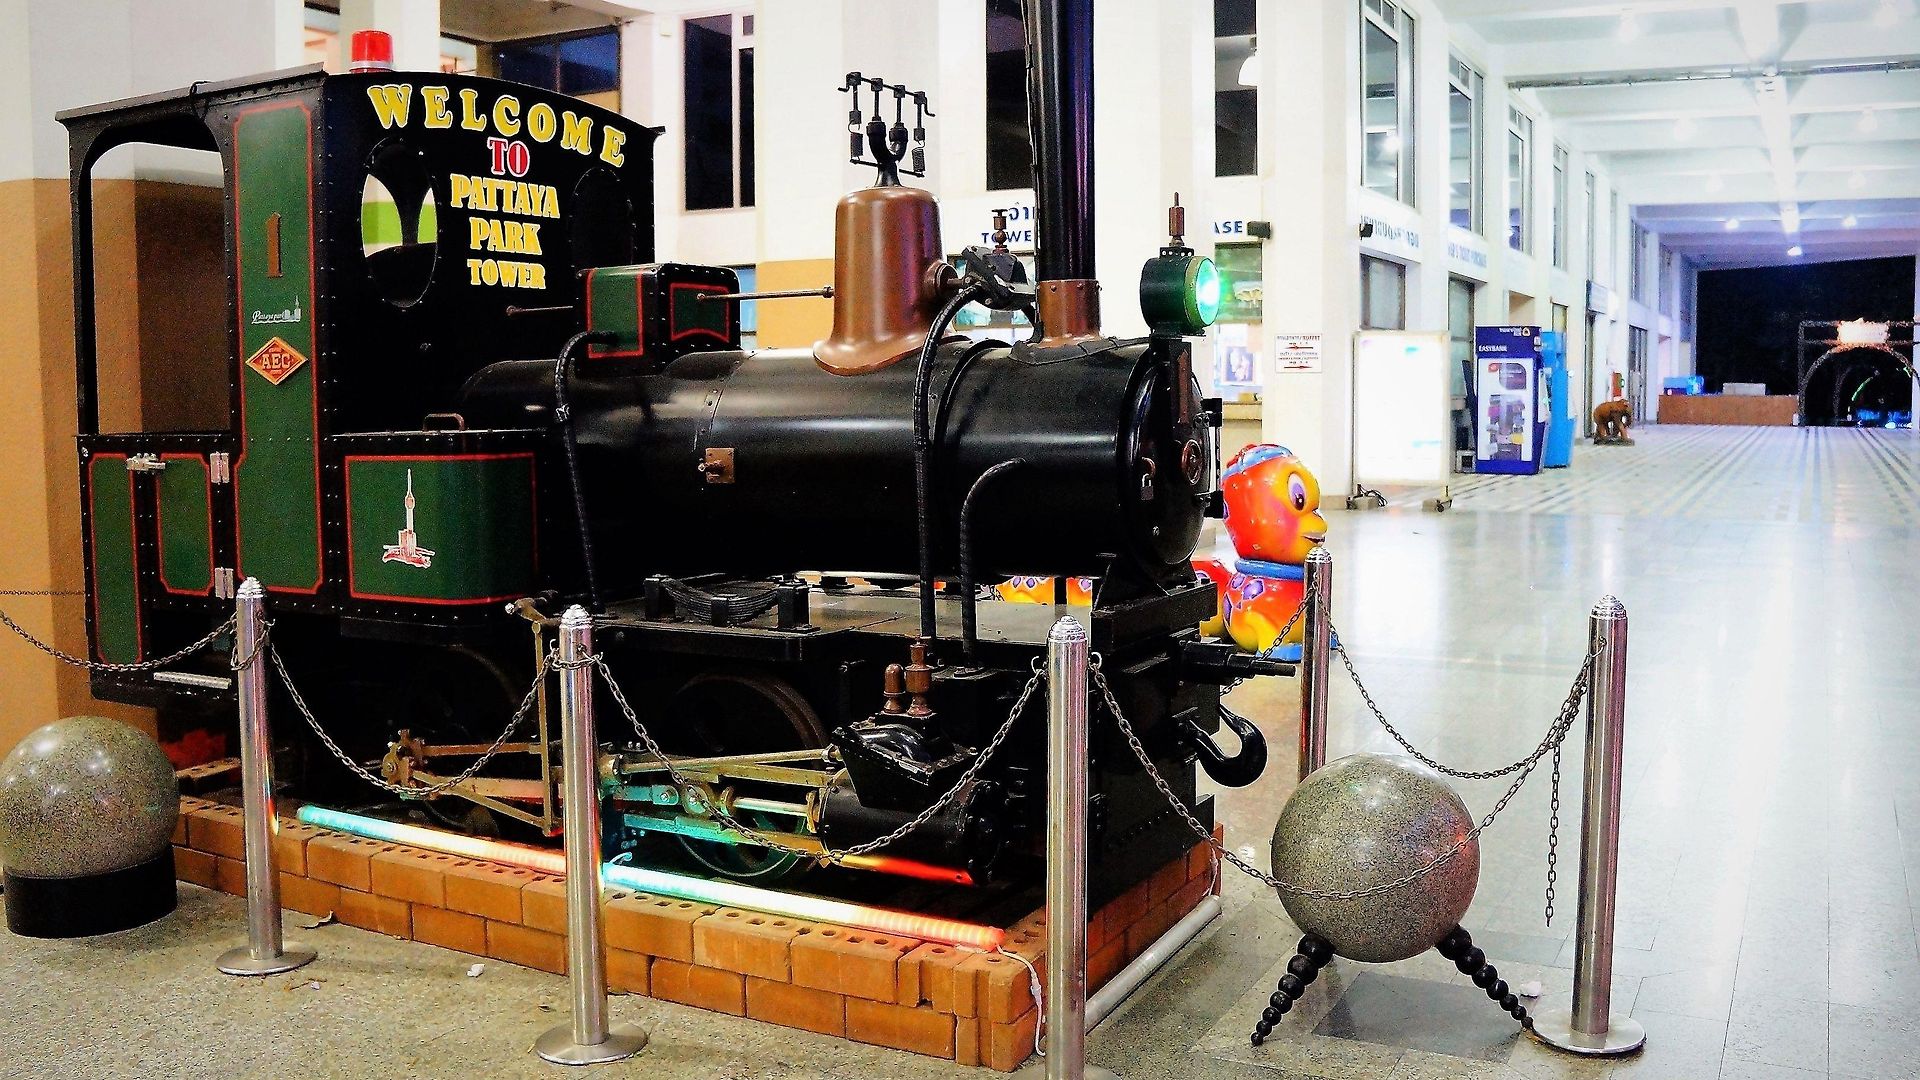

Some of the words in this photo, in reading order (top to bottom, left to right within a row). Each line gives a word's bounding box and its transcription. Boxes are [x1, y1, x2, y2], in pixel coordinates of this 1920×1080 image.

[367, 83, 627, 167] WELCOME
[487, 137, 530, 177] TO
[450, 174, 560, 219] PATTAYA
[265, 211, 284, 279] 1
[469, 217, 542, 255] PARK
[467, 259, 546, 289] TOWER
[261, 353, 291, 370] AEC
